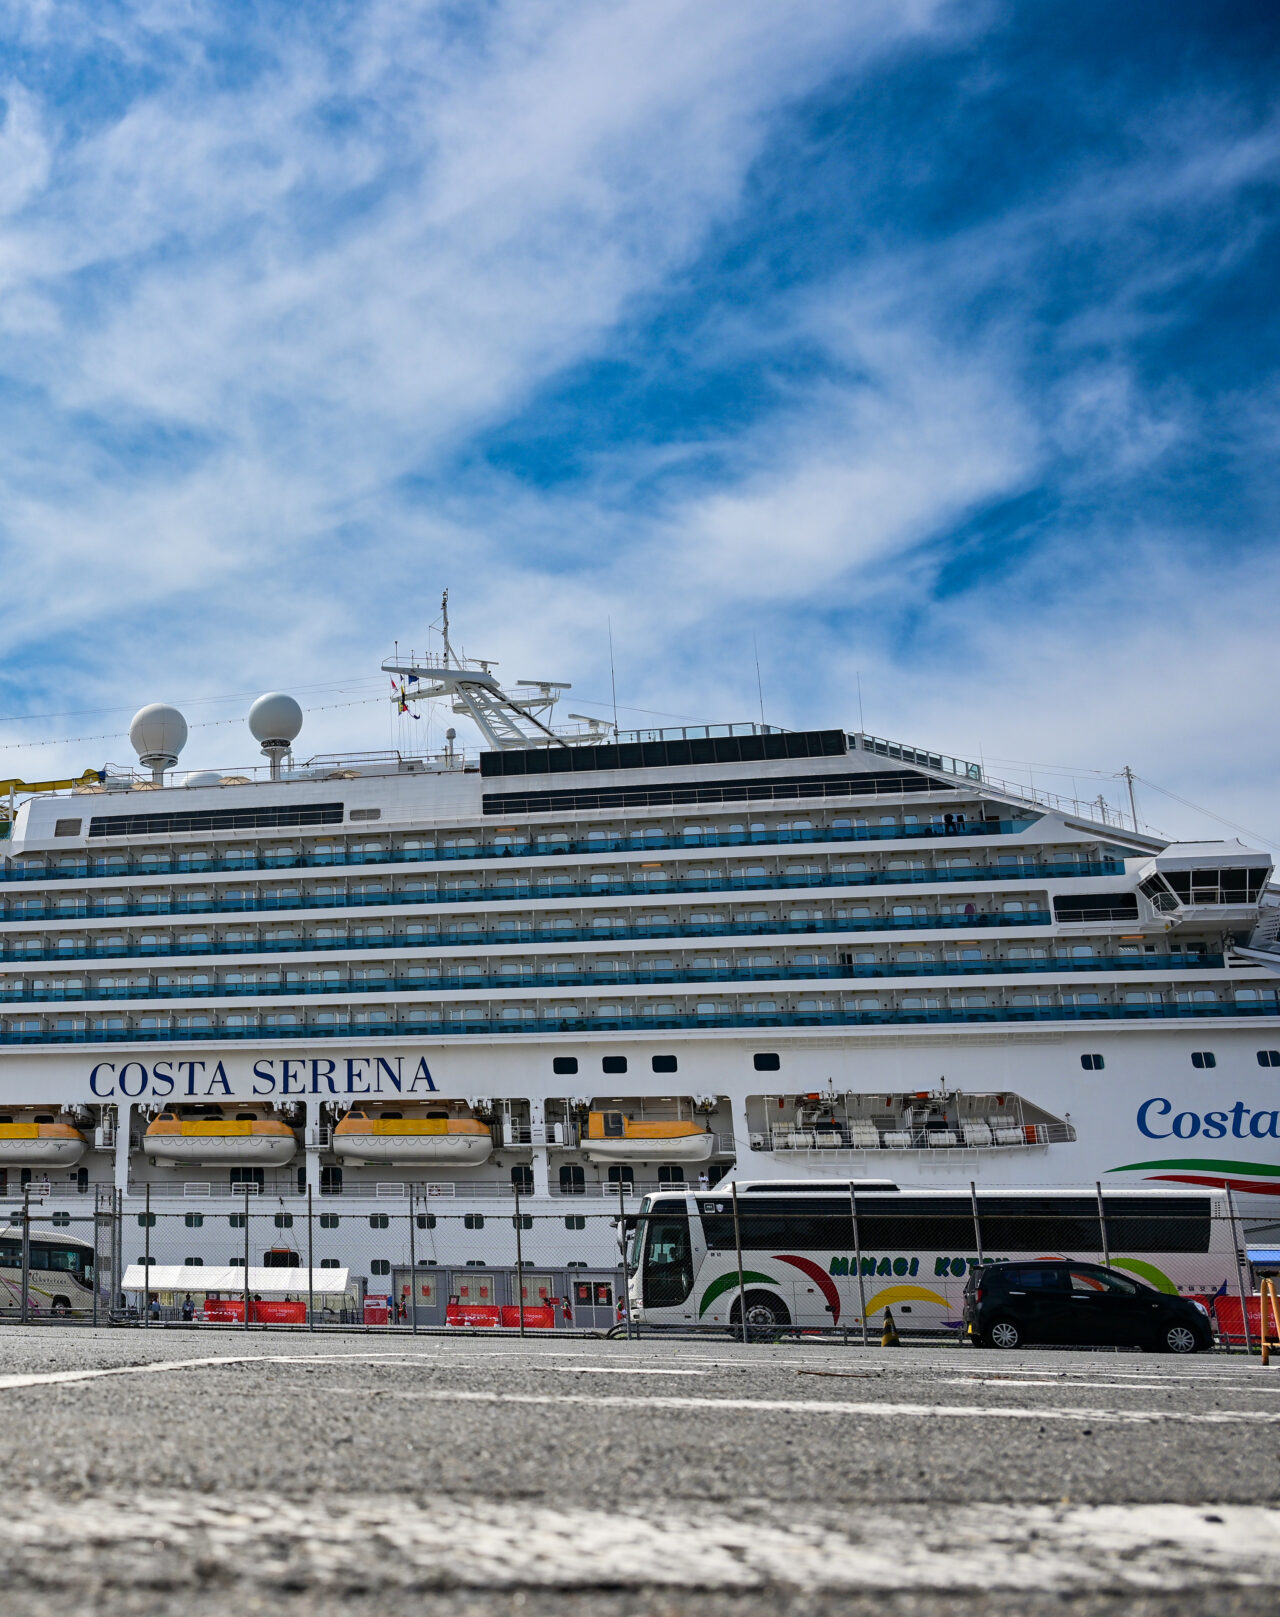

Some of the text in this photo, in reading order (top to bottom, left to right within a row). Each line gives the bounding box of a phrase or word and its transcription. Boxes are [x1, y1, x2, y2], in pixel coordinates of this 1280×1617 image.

[89, 1056, 441, 1097] COSTA SERENA
[1136, 1097, 1280, 1139] Costa
